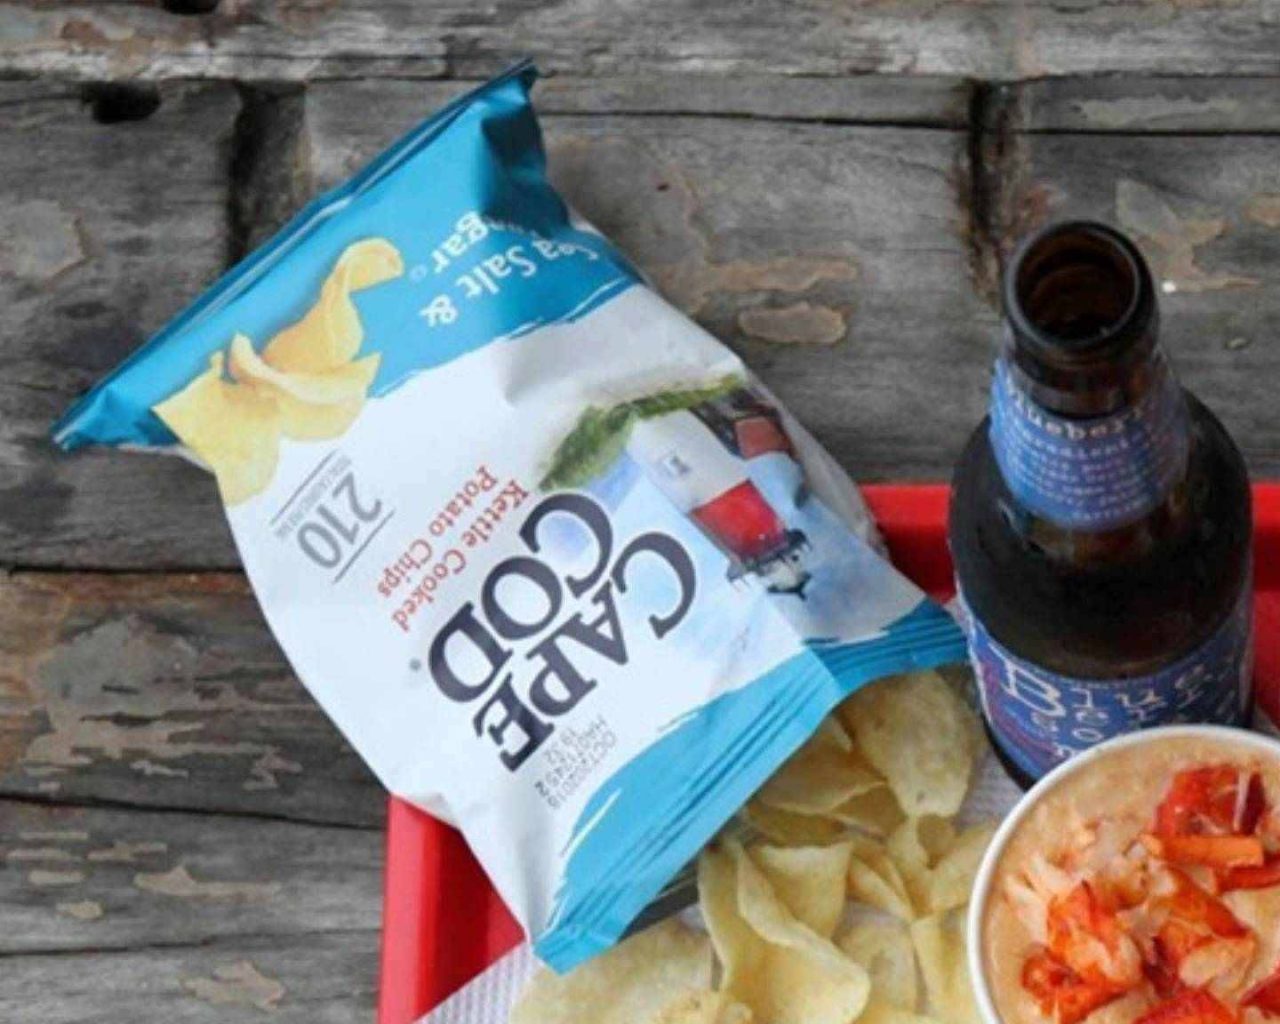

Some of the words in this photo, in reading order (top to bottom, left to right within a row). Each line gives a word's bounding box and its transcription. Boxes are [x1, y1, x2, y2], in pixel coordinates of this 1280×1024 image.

[454, 245, 538, 300] Salt
[418, 293, 460, 329] &
[297, 470, 384, 571] 210
[428, 463, 499, 538] Potato
[461, 479, 529, 548] Kettle
[376, 538, 433, 599] Chips
[391, 548, 467, 633] Cooked
[427, 493, 614, 704] COD
[472, 531, 698, 773] CAPE
